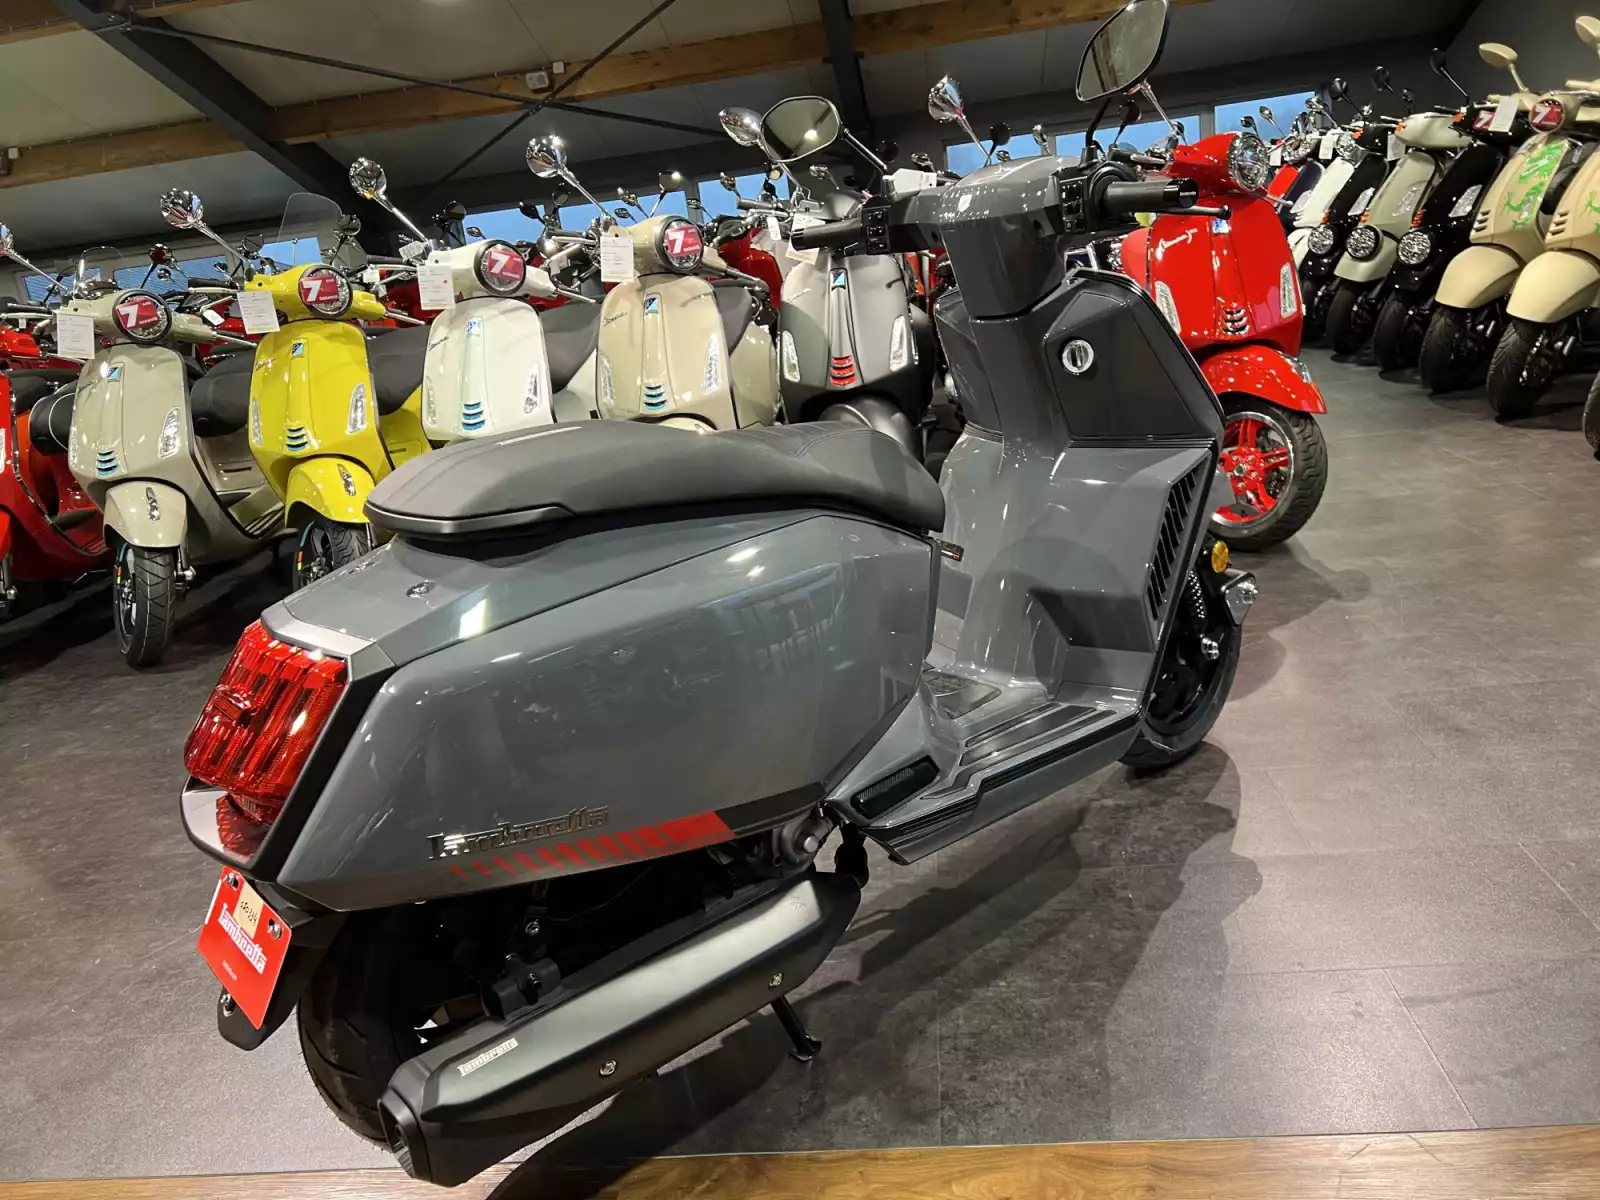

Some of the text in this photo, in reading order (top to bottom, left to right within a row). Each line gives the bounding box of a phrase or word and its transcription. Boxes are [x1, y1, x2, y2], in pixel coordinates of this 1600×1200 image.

[1476, 110, 1494, 128] 7
[1532, 105, 1552, 124] 7
[667, 230, 685, 254] 7
[490, 251, 511, 274] 7
[302, 279, 322, 302] 7
[118, 304, 139, 328] 7
